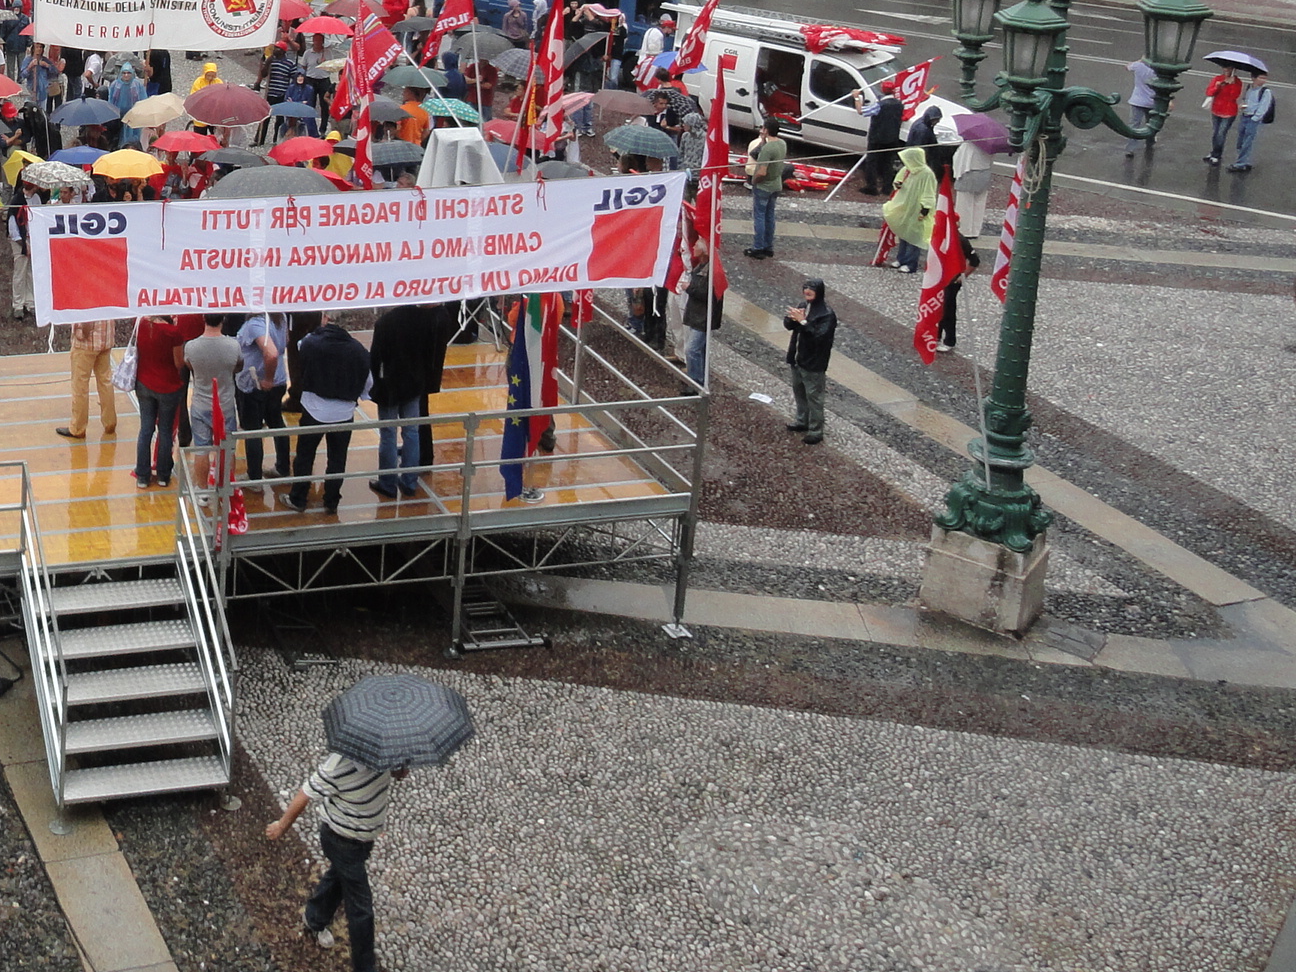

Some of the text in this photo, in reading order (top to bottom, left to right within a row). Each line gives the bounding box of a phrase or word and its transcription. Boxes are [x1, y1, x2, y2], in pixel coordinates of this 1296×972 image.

[115, 1, 146, 13] DELLA
[75, 23, 155, 39] BERGAMO
[724, 48, 739, 56] CGIL
